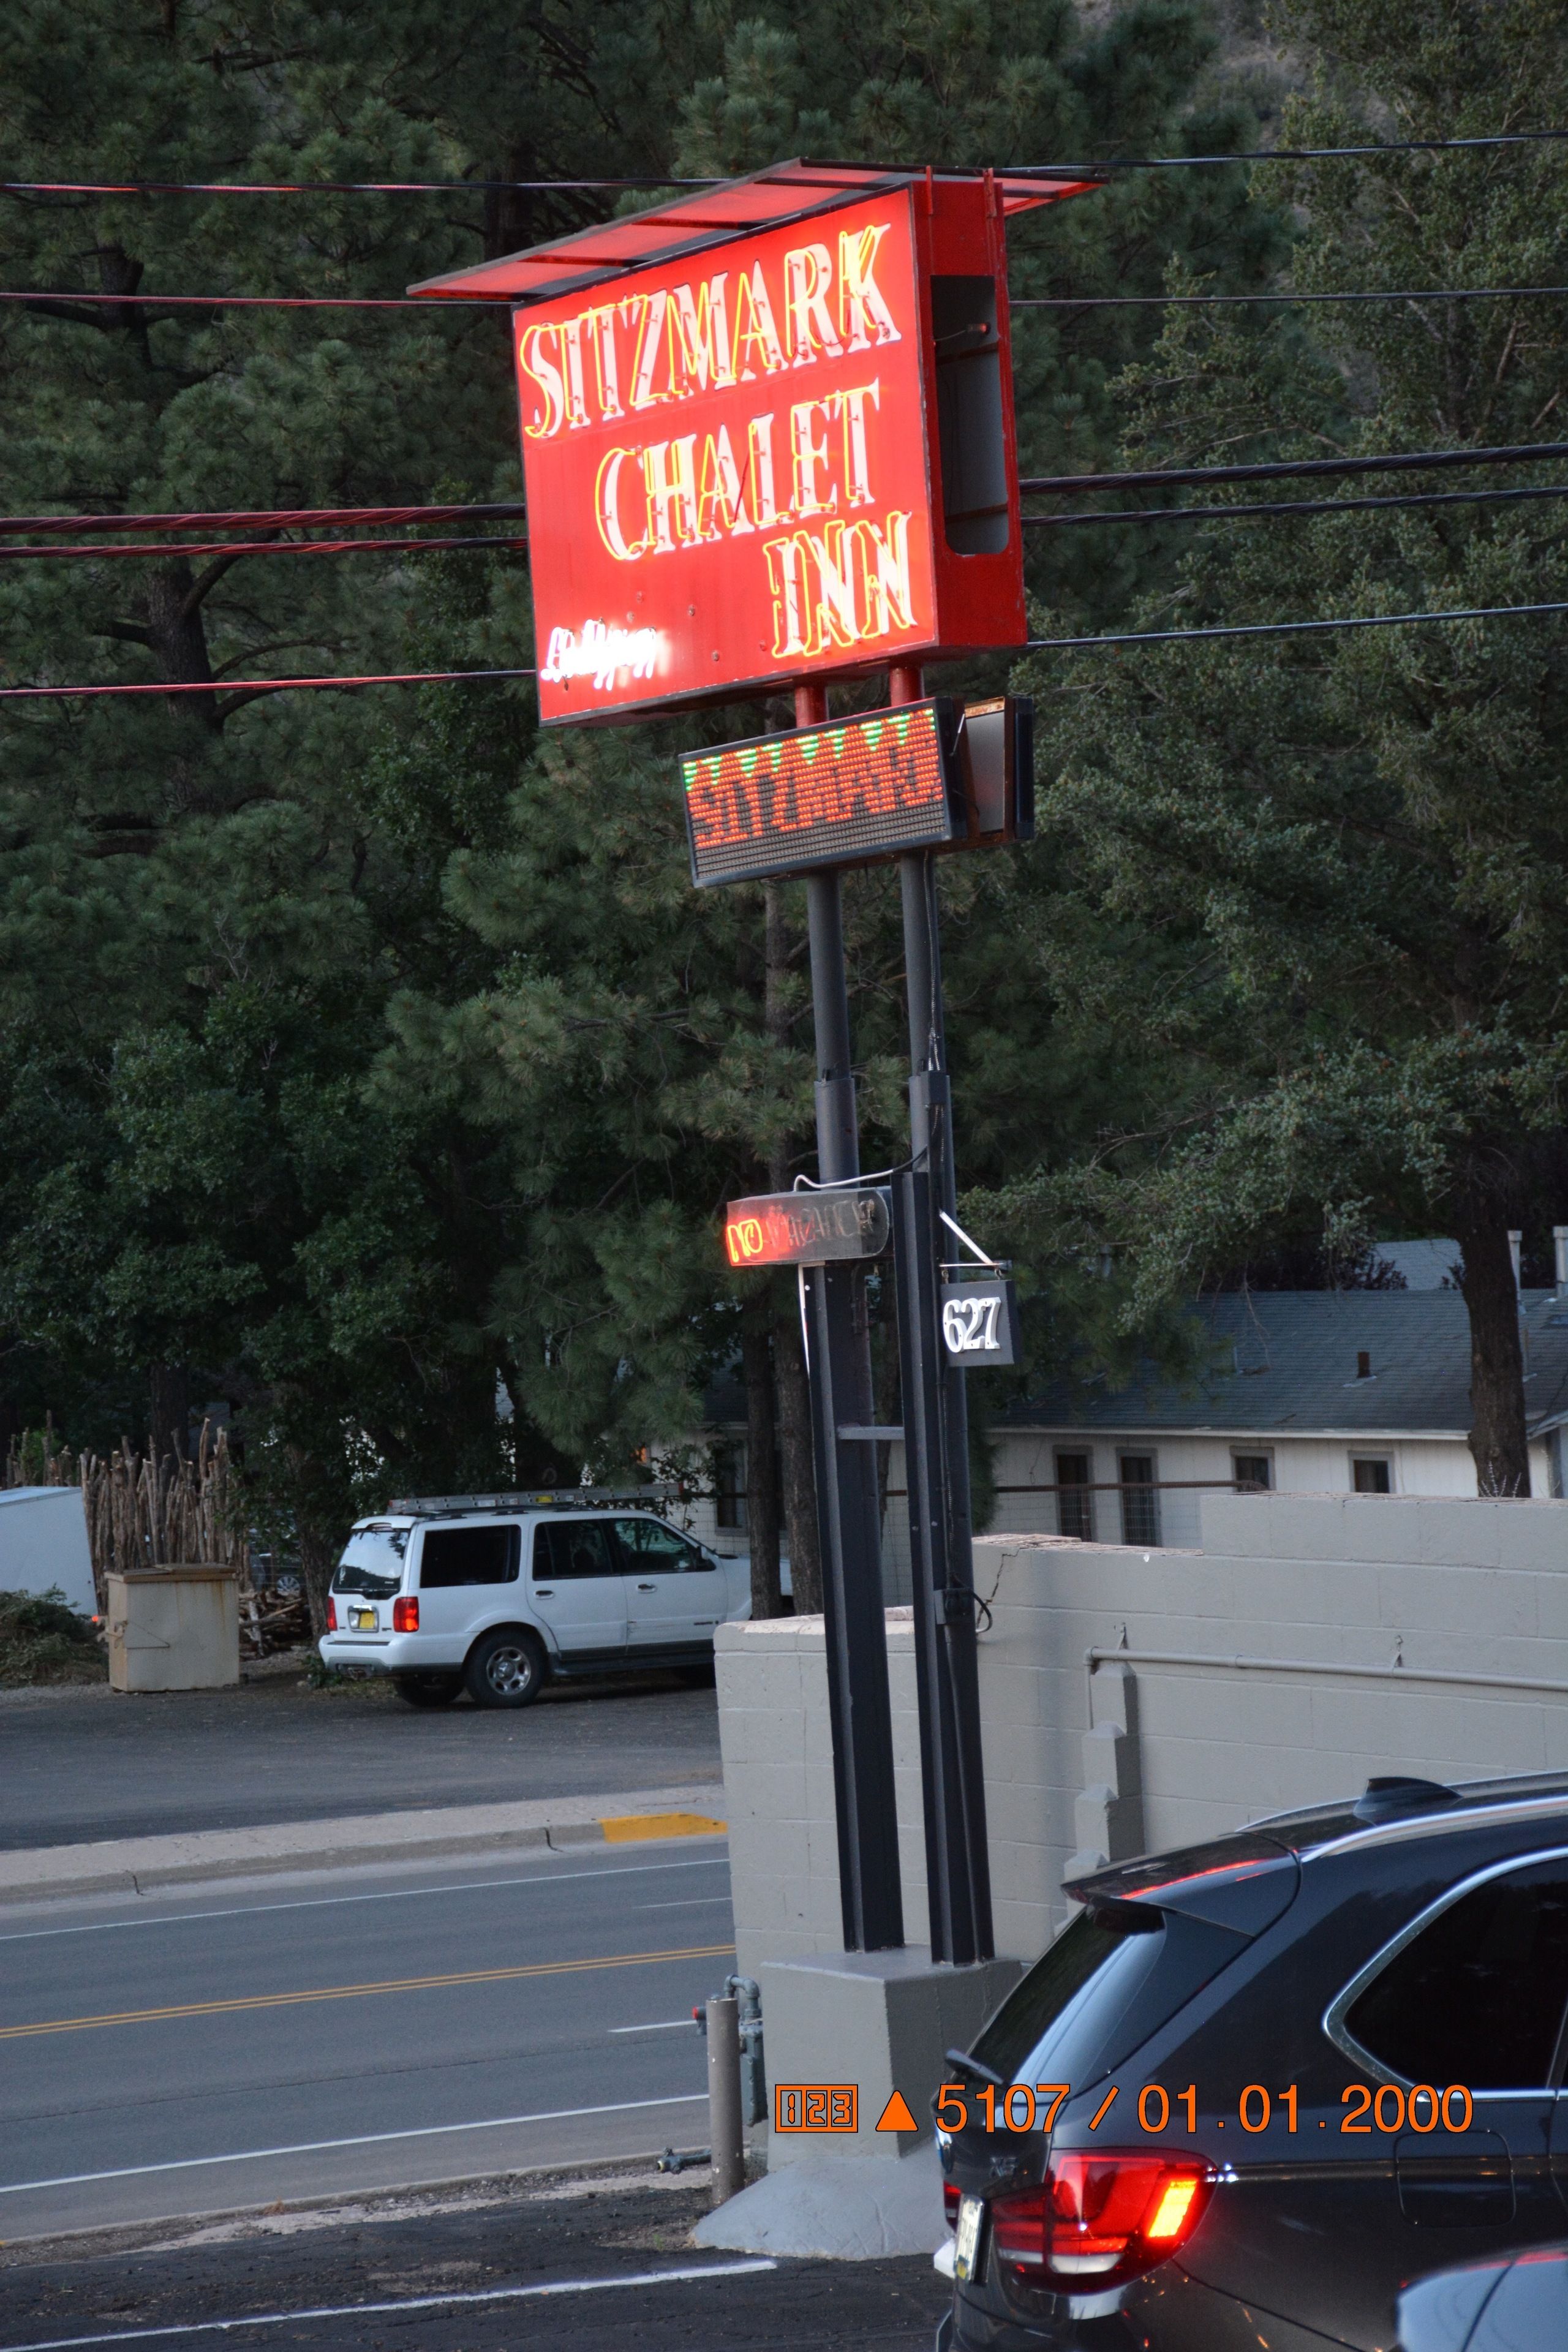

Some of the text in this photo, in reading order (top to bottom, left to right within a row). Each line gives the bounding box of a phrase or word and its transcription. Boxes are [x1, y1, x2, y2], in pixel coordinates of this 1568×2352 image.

[519, 222, 903, 439] SITZMARK
[595, 377, 880, 562] CHALET
[763, 510, 917, 660] INN
[727, 1219, 763, 1263] NO
[943, 1297, 1001, 1353] 627
